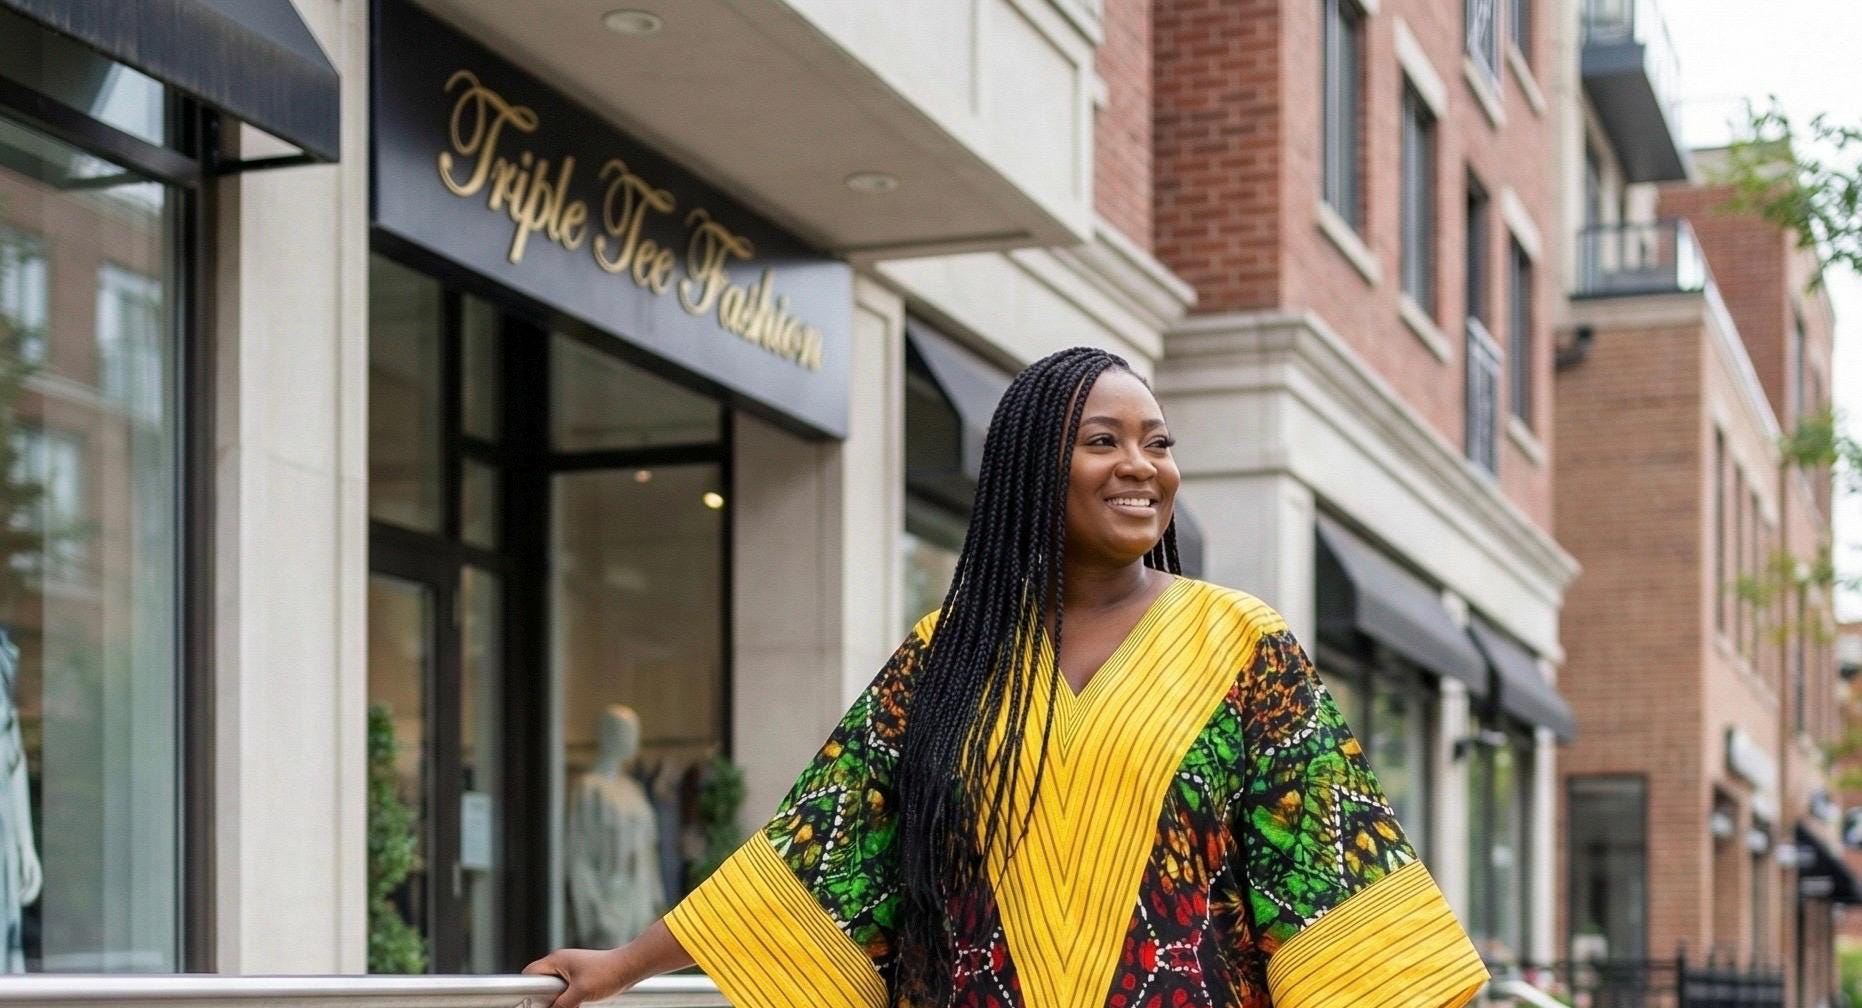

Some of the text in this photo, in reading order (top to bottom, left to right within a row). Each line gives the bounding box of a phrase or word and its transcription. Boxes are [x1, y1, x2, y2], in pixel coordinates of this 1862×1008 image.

[439, 70, 823, 371] Triple Tee Fashion
